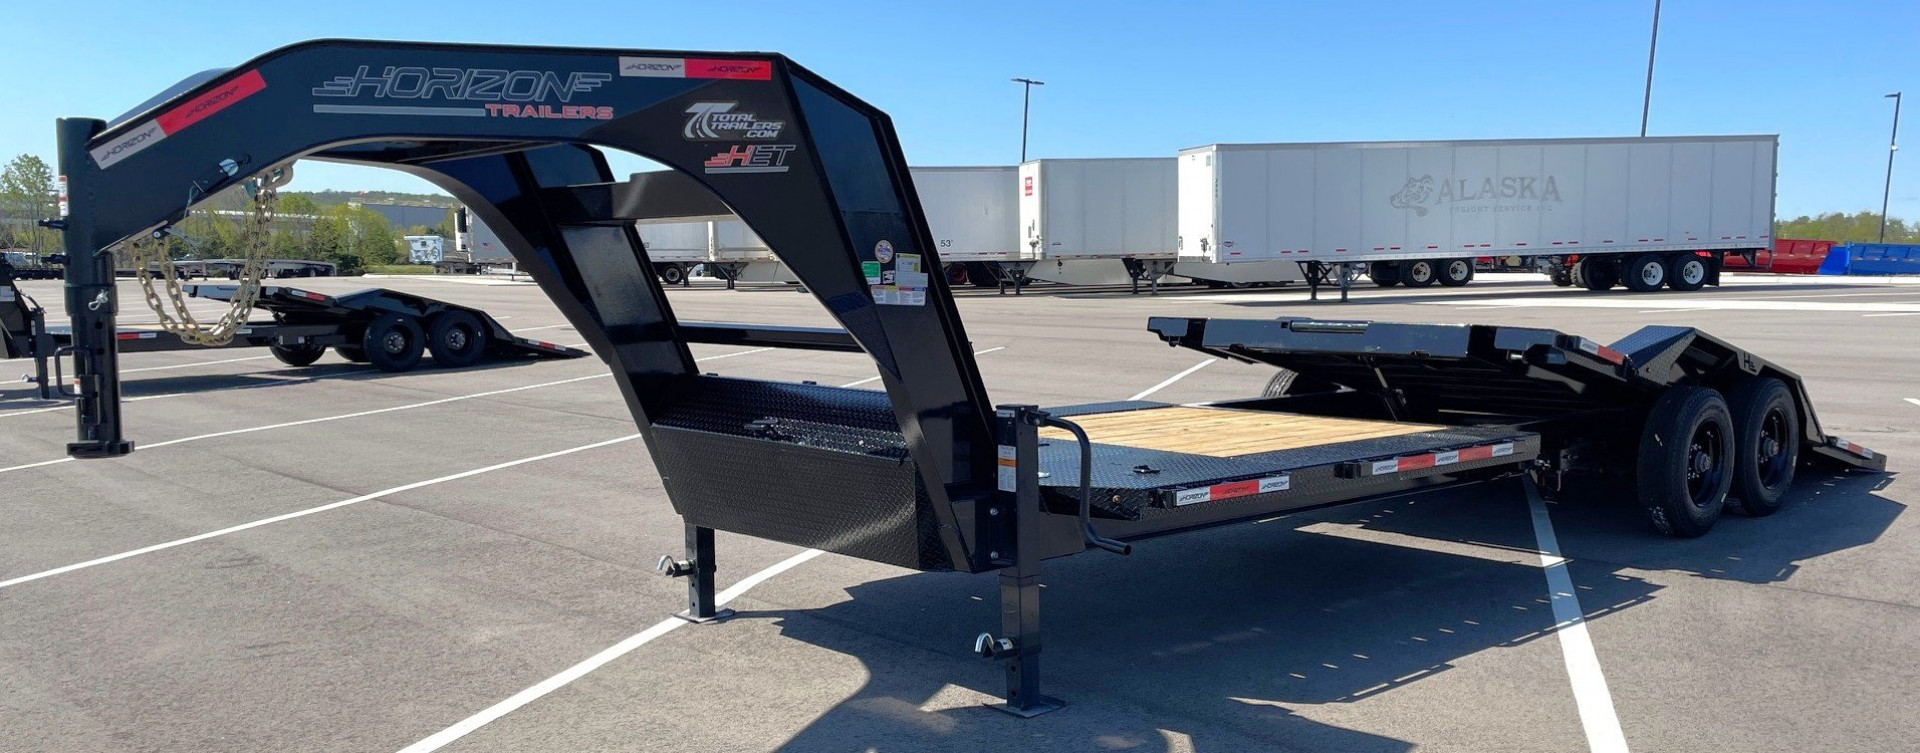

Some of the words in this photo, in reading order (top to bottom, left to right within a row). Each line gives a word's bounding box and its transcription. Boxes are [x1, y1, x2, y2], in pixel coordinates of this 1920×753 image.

[629, 62, 679, 72] HORIZON
[338, 65, 598, 102] HORIZON
[485, 103, 614, 120] TRAILERS
[711, 113, 757, 122] TOTAL
[711, 121, 782, 130] TRAILERS
[743, 130, 778, 138] .COM
[104, 128, 154, 158] HORIZON
[718, 145, 797, 166] HET
[1435, 175, 1563, 205] ALASKA
